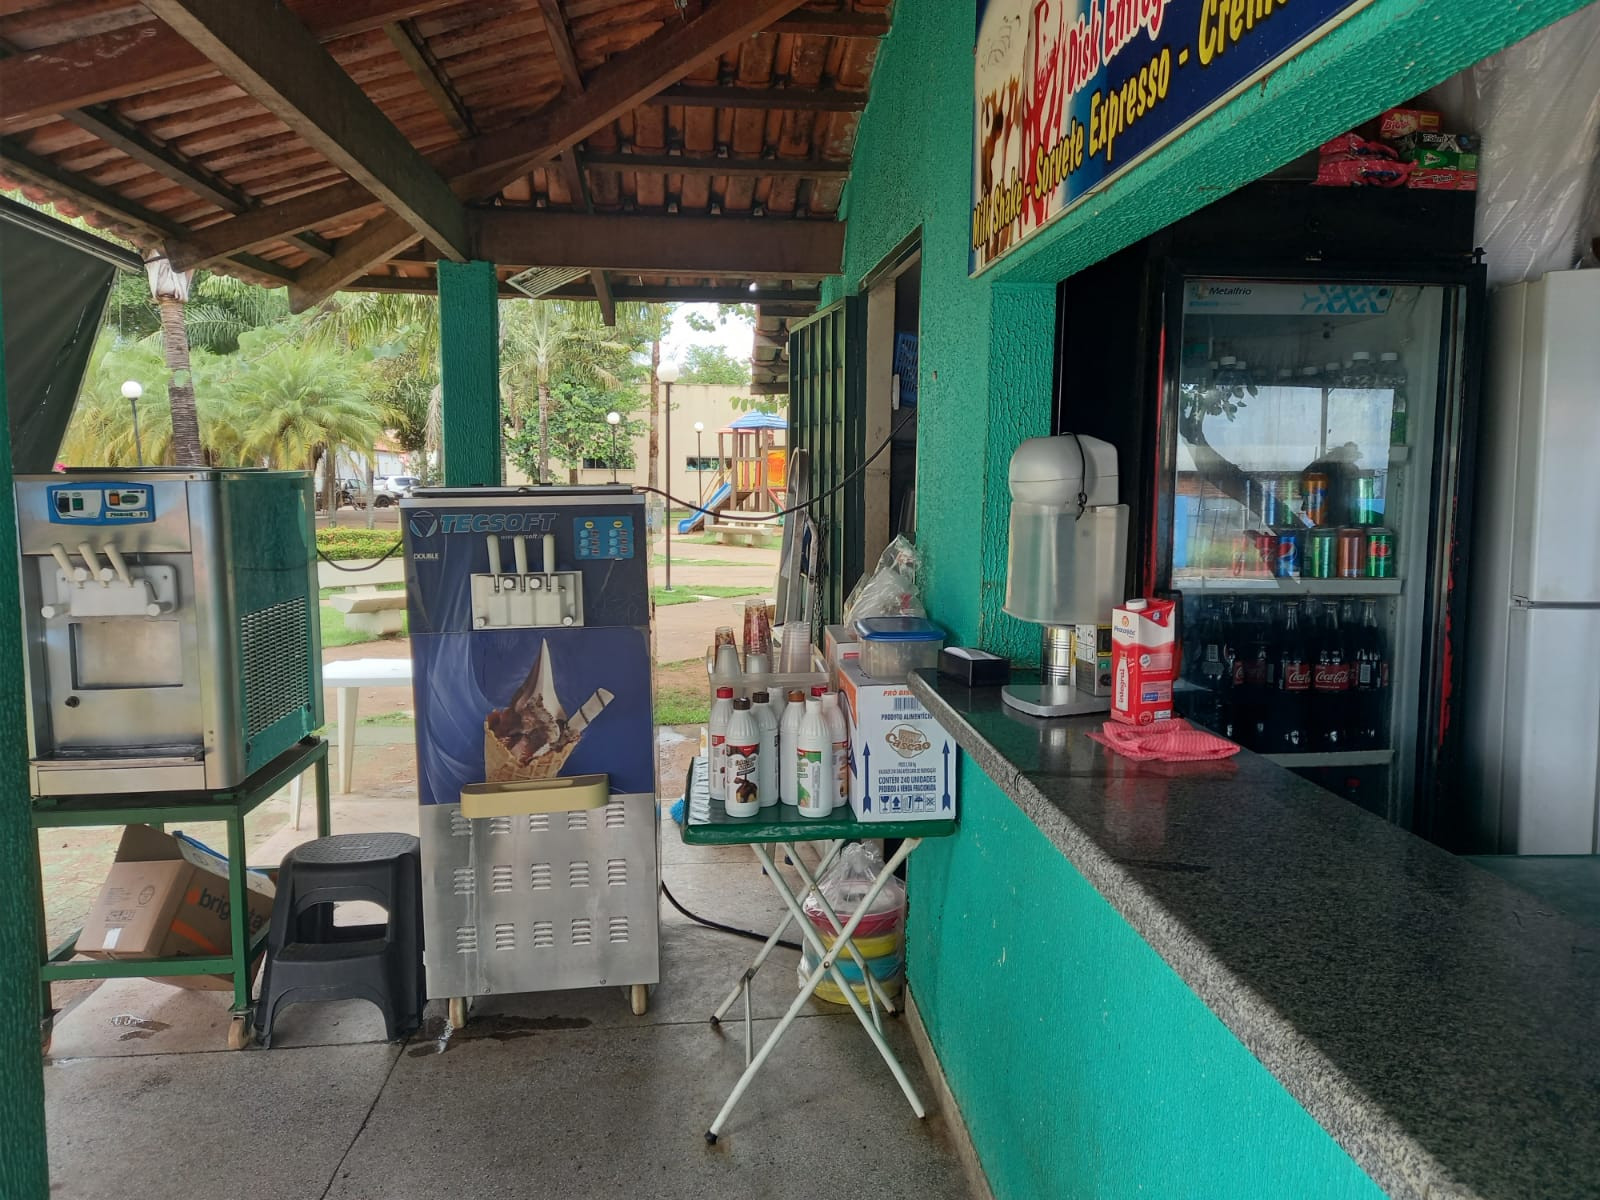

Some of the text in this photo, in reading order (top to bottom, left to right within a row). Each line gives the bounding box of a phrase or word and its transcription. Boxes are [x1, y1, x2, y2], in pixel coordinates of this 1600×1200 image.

[1066, 0, 1100, 97] Disk
[972, 185, 992, 251] Milk
[993, 167, 1023, 236] Shake
[1034, 116, 1084, 202] Sorvete
[1089, 48, 1171, 162] Expresso
[1208, 286, 1252, 297] Metalfrio
[440, 512, 557, 534] TECSOFT
